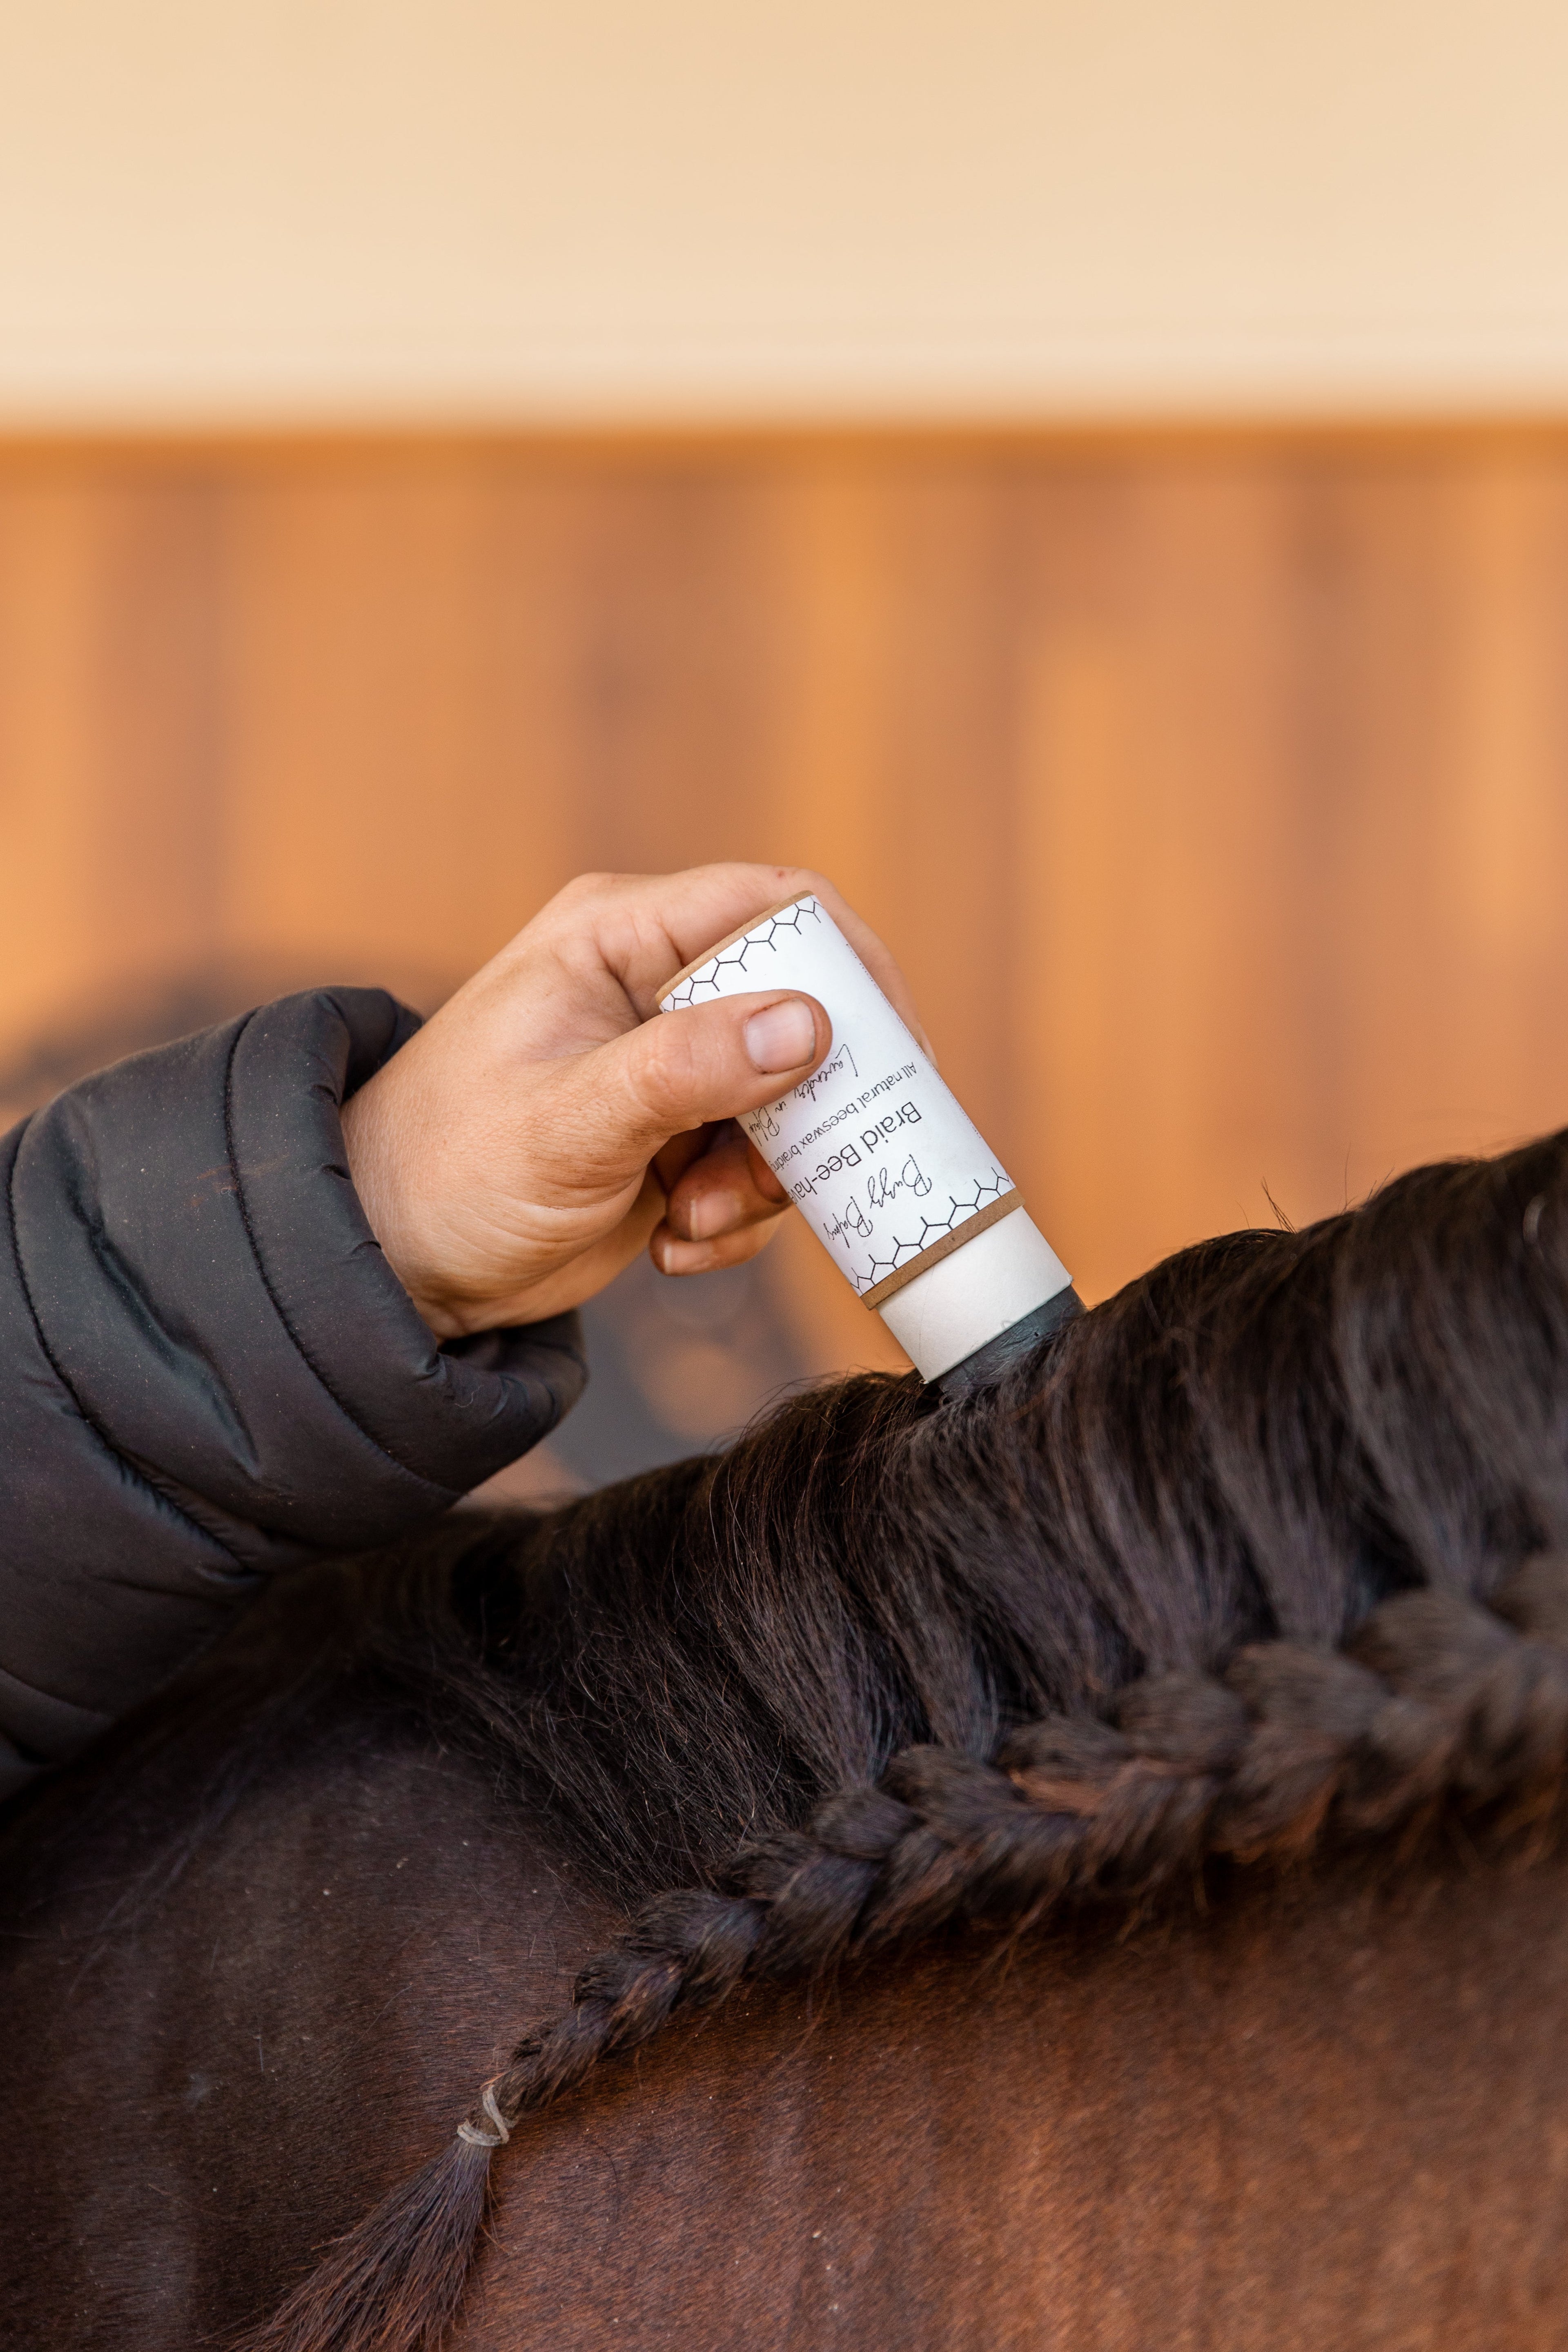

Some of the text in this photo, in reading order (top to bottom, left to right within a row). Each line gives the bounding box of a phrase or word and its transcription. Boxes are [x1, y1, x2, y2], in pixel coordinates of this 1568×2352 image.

[749, 1044, 858, 1147] Lavender in Black
[768, 1062, 916, 1172] All natural beeswax braiding
[860, 1101, 922, 1154] Braid
[823, 1154, 932, 1249] Buzz Balms
